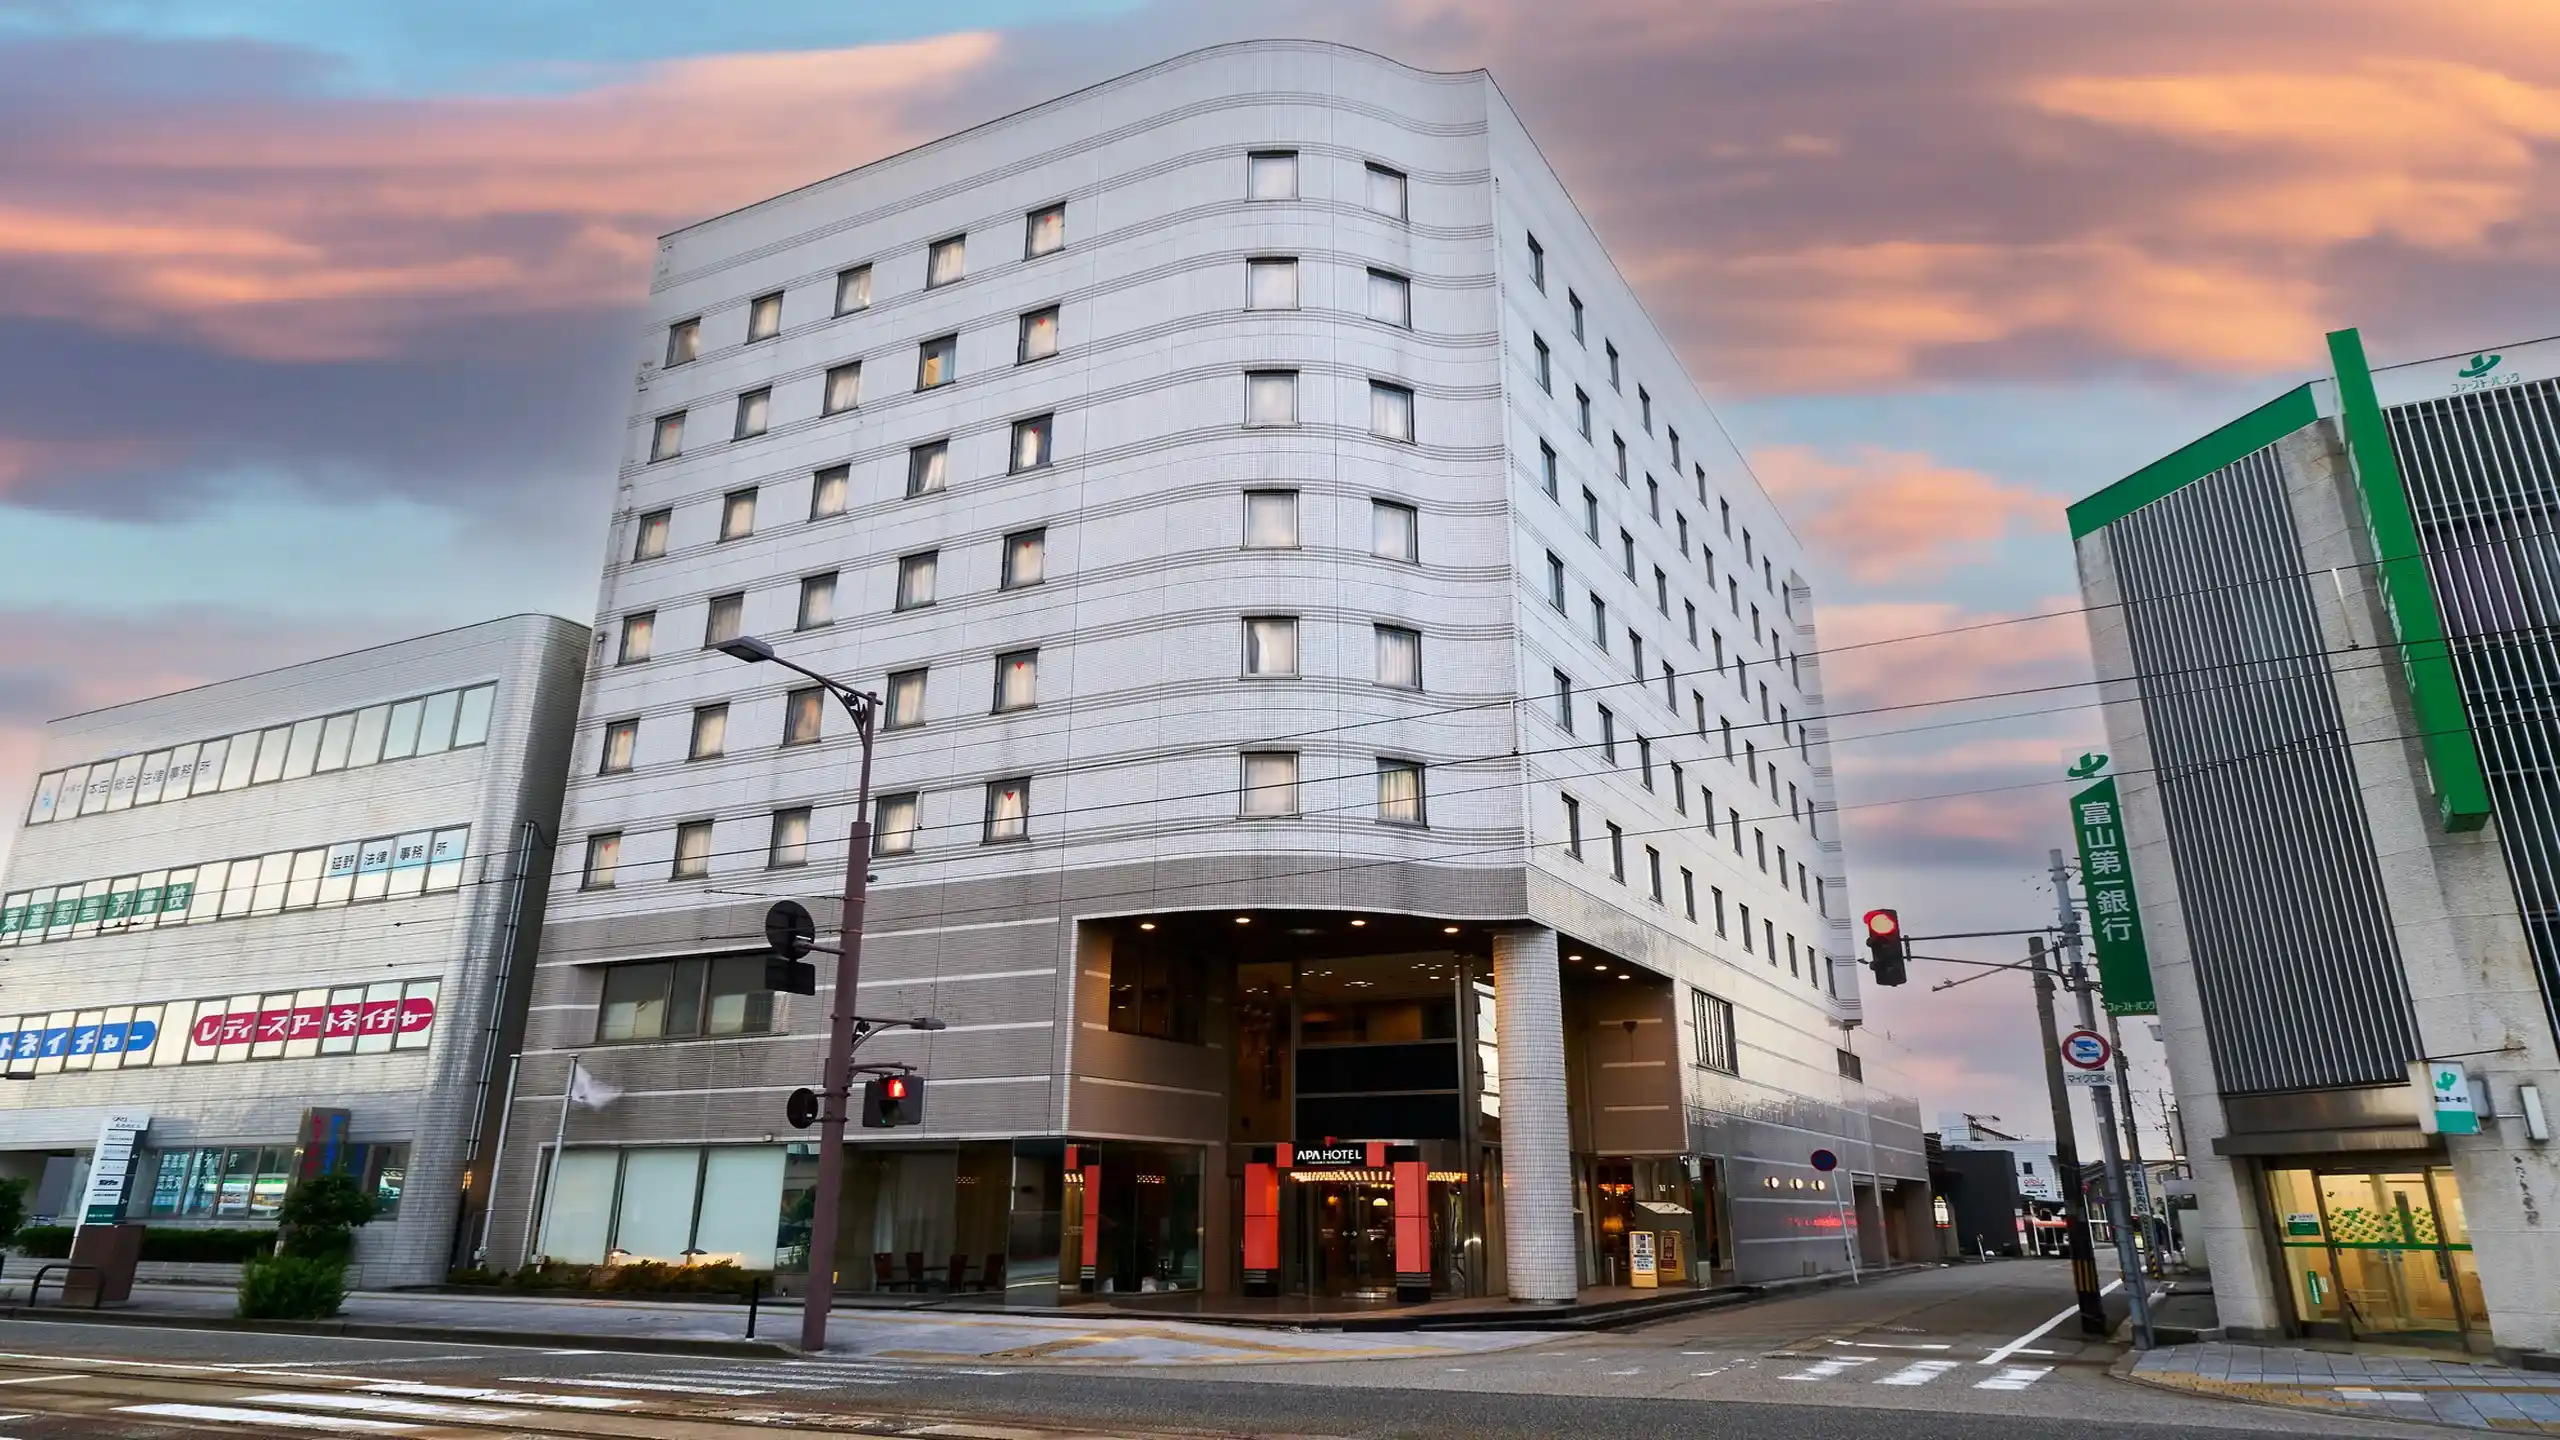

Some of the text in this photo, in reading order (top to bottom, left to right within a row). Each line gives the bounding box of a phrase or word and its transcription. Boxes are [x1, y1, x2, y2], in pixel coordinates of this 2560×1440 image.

[2080, 801, 2133, 943] 富山第一銀行
[200, 1008, 432, 1041] レディースアートネイチャー
[2067, 1074, 2113, 1084] マイクロ除く
[1297, 1149, 1362, 1160] APA HOTEL
